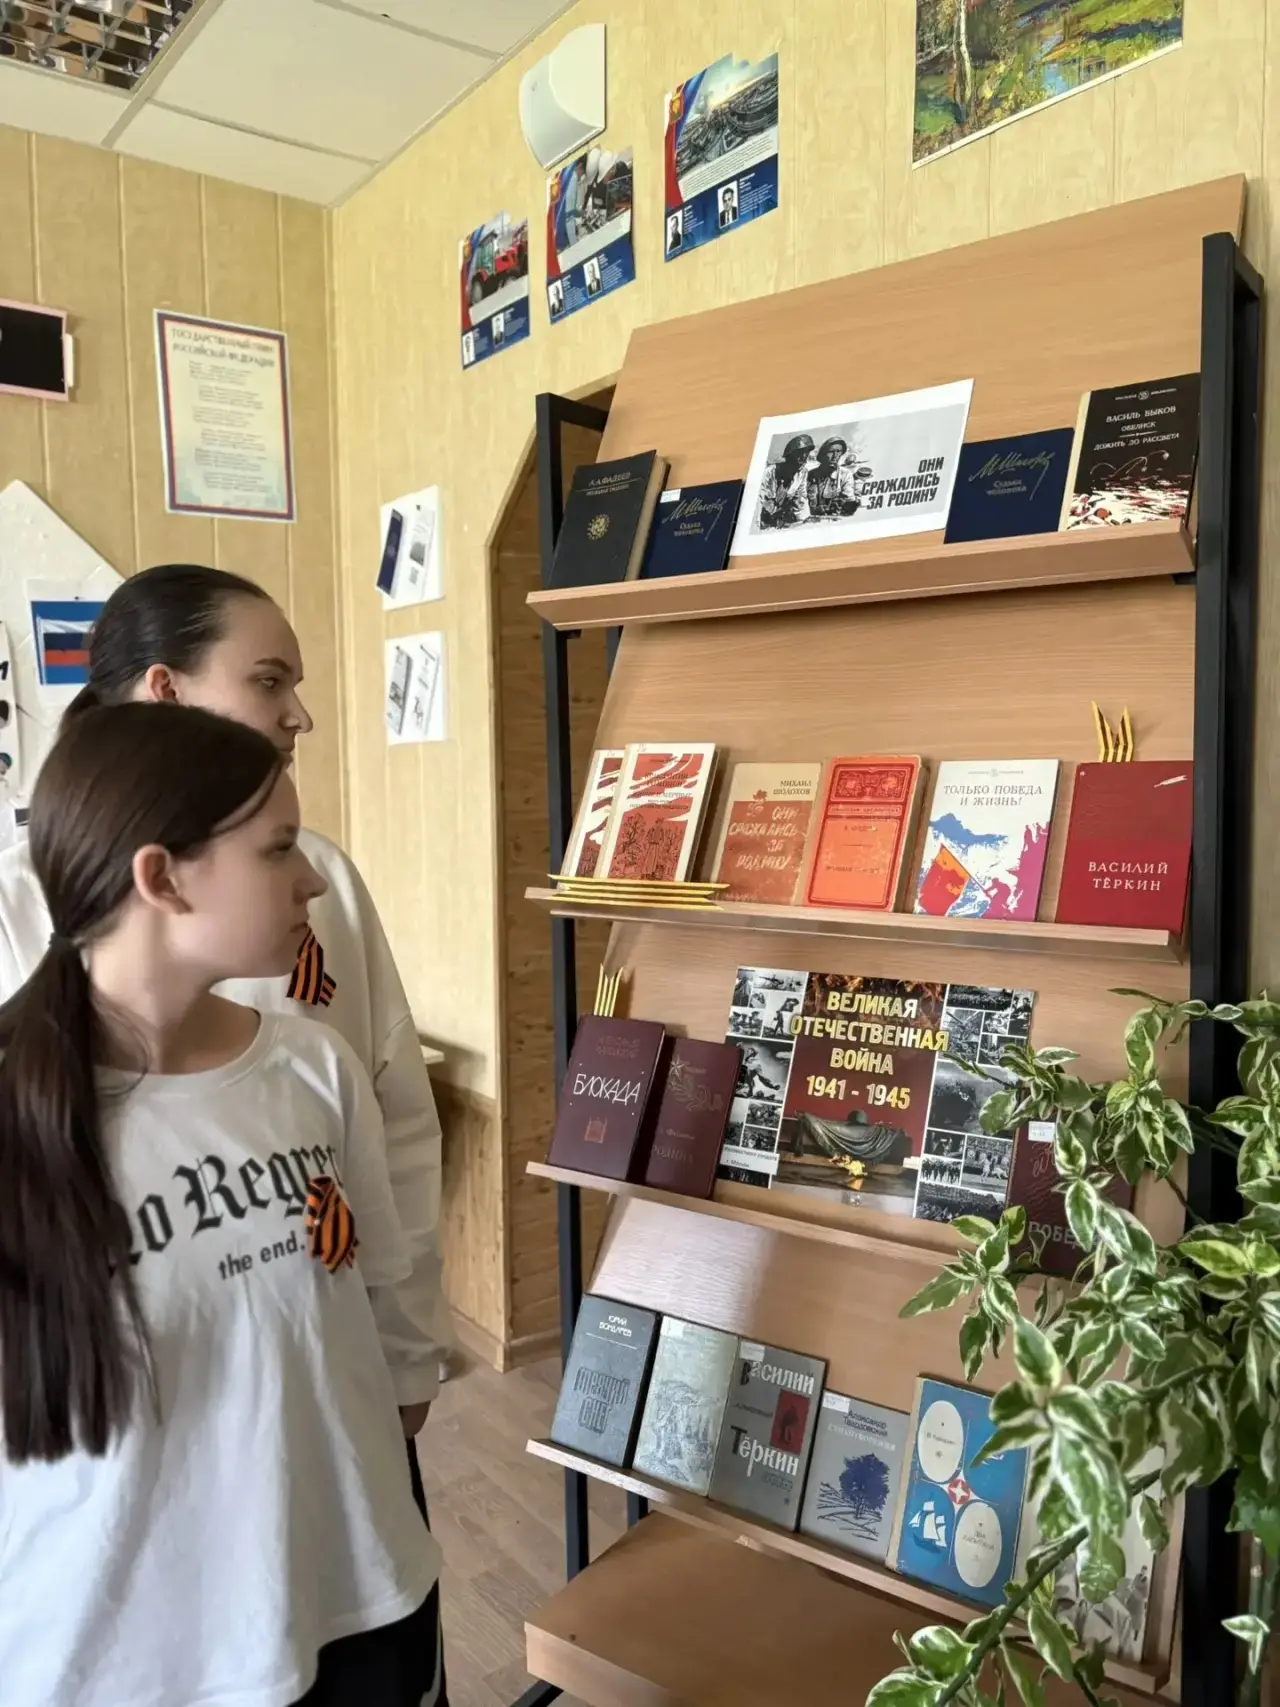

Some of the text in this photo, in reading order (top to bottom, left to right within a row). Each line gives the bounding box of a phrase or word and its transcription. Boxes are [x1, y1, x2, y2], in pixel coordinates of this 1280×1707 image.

[1106, 406, 1177, 423] ВАСИЛЬ БЫКОВ
[1121, 421, 1156, 431] ОБЕЛИСК
[1093, 432, 1180, 450] ДОЖИТЬ ДО РАССВЕТА
[918, 456, 944, 473] ОНИ
[861, 472, 940, 496] СРАЖАЛИСЬ
[866, 487, 938, 510] ЗА РОДИНУ
[944, 785, 1042, 796] ТОЛЬКО ПОБЕДА
[960, 796, 1022, 806] И ЖИЗНЬ!
[1088, 861, 1168, 874] ВАСИЛИЙ
[1092, 877, 1161, 891] ТЁРКИН
[826, 991, 918, 1019] ВЕЛИКАЯ
[790, 1014, 950, 1052] ОТЕЧЕСТВЕННАЯ
[829, 1047, 894, 1075] ВОЙНА
[573, 1073, 641, 1106] БЛОКАДА
[806, 1075, 846, 1100] 1941
[866, 1083, 911, 1109] 1945
[131, 1193, 174, 1265] o
[218, 1230, 306, 1280] the end.
[599, 1322, 632, 1337] БОНДАРЕВ
[608, 1315, 627, 1326] ЮРИЙ
[730, 1425, 799, 1477] Тёркин
